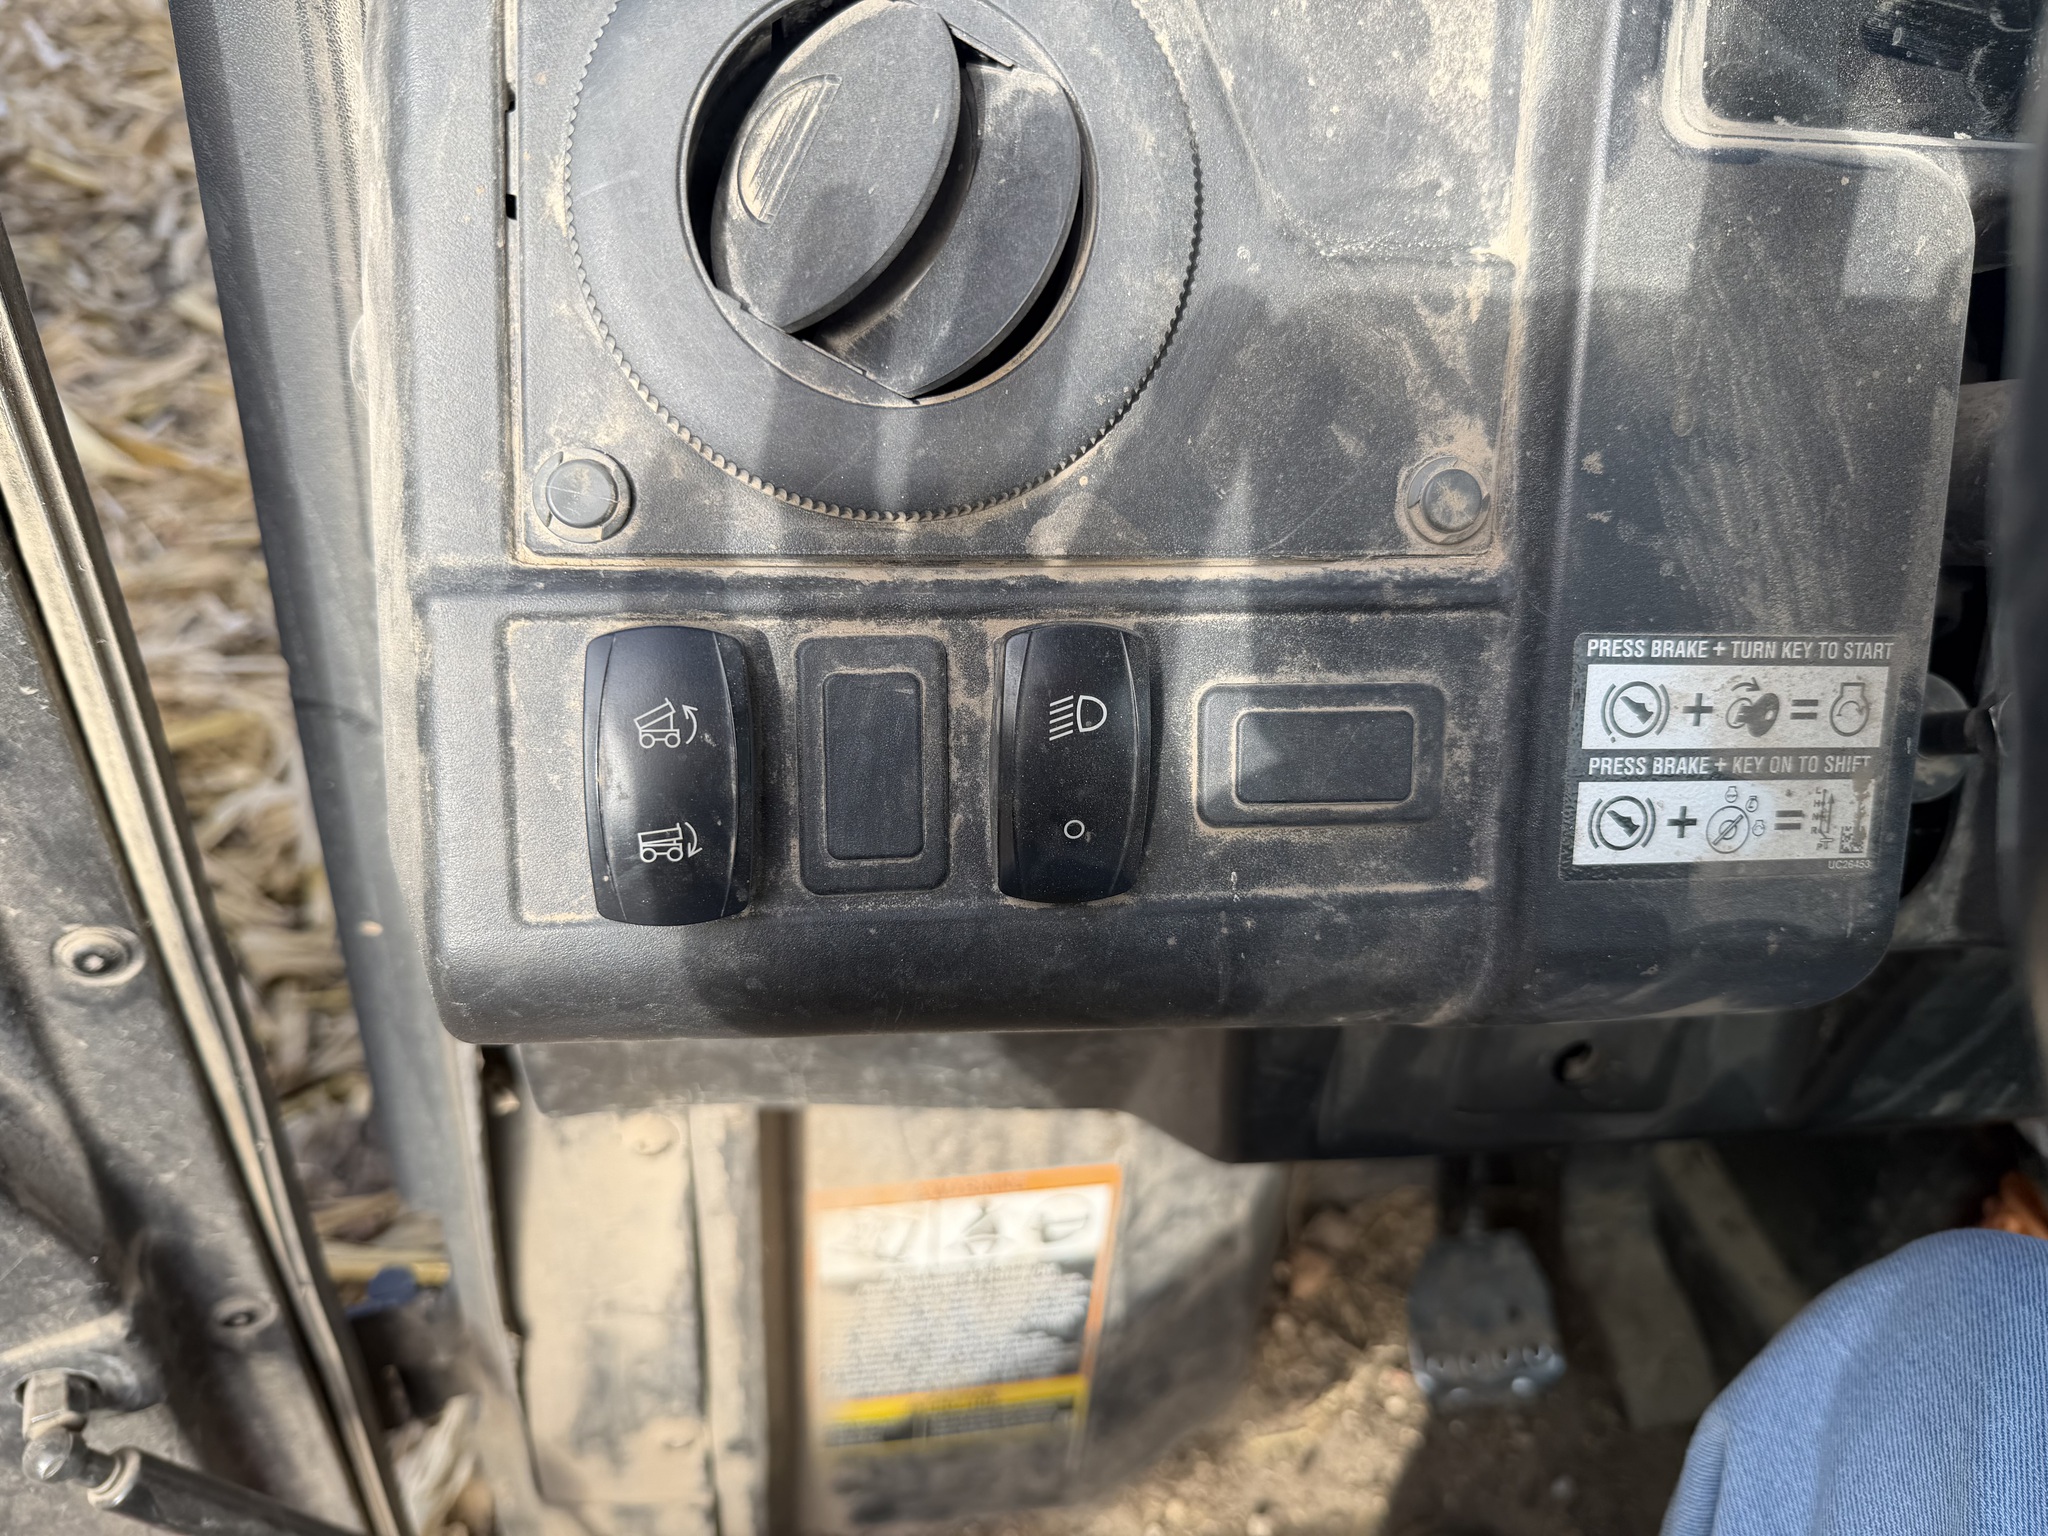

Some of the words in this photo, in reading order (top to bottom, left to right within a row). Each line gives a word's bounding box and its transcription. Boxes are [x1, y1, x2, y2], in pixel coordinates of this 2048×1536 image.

[1587, 639, 1645, 658] PRESS
[1650, 640, 1709, 659] BRAKE
[1731, 641, 1776, 660] TURN
[1781, 641, 1813, 660] KEY
[1818, 642, 1838, 660] TO
[1843, 642, 1895, 660] START
[1588, 757, 1646, 775] PRESS
[1652, 757, 1709, 775] BRAKE
[1732, 756, 1764, 774] KEY
[1769, 756, 1794, 774] ON
[1798, 756, 1818, 773] TO
